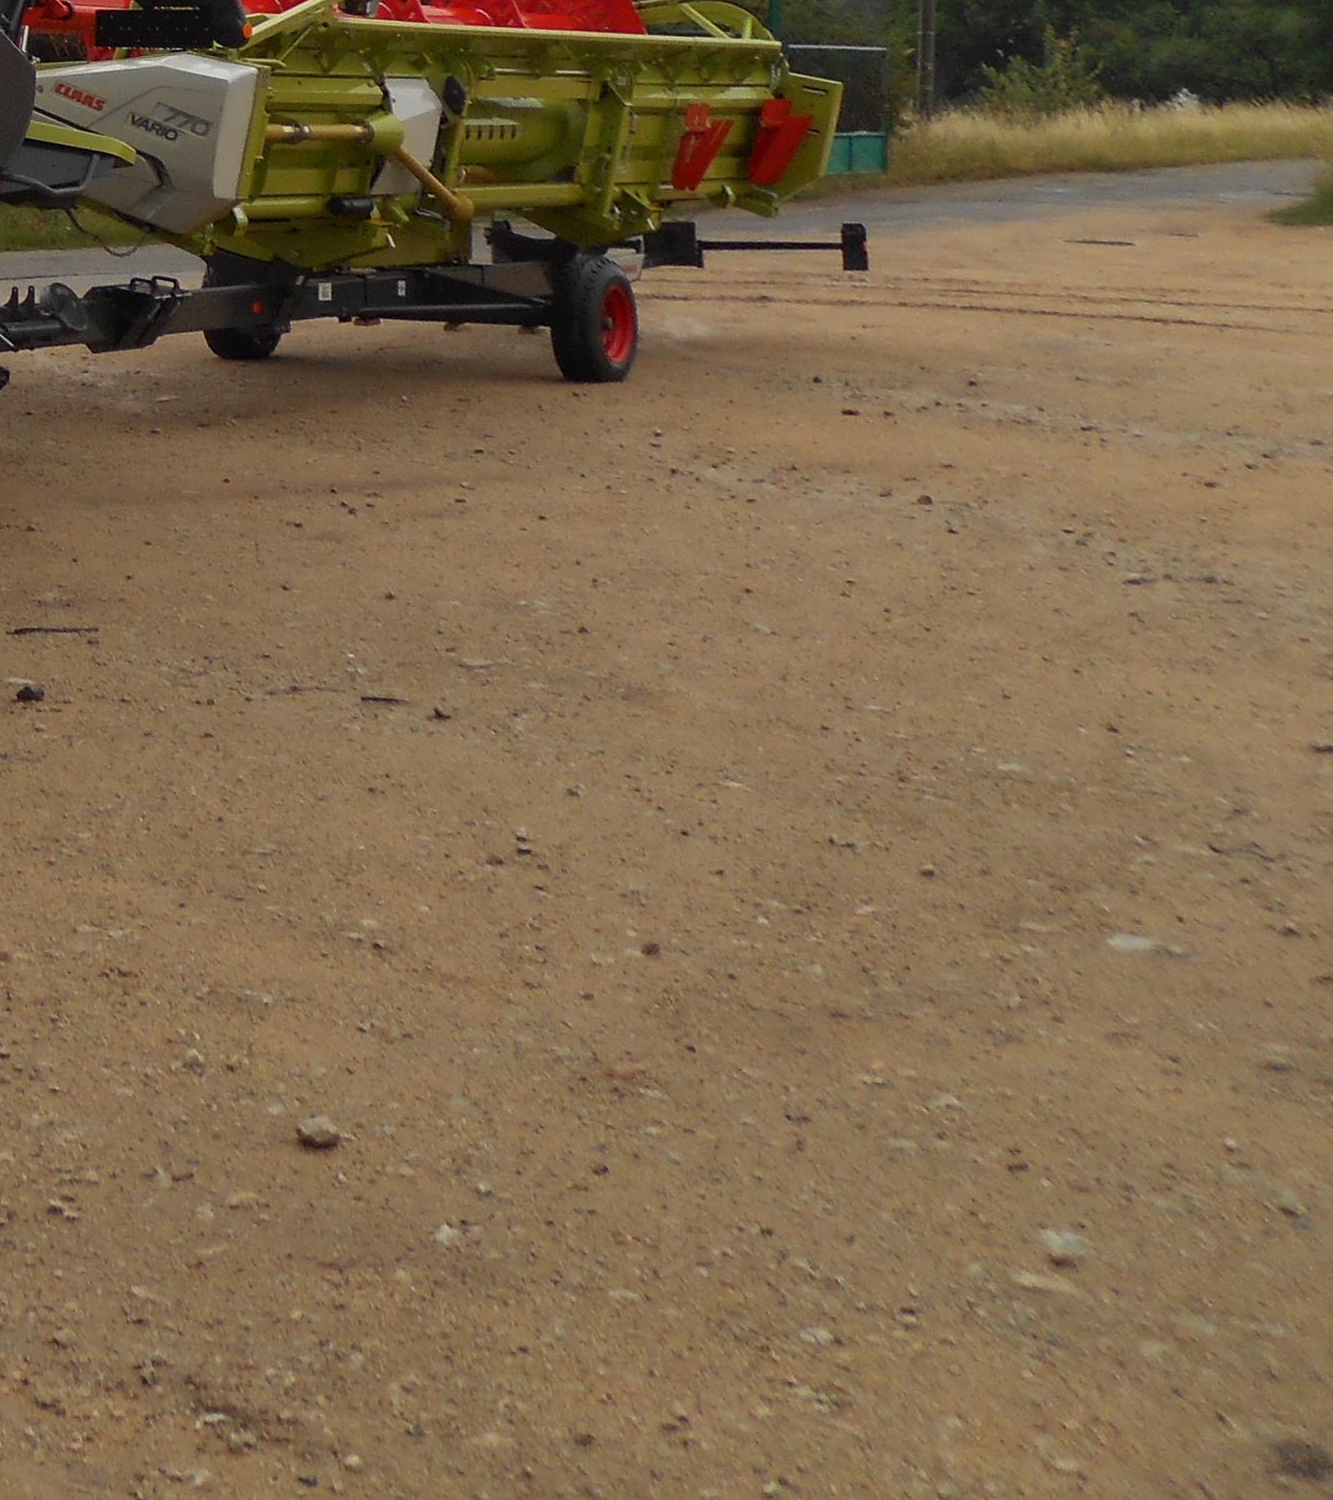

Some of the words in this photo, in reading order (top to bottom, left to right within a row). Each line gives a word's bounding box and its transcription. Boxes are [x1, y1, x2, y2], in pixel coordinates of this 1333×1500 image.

[55, 83, 106, 112] CLAAS
[130, 113, 178, 141] VARIO
[153, 102, 214, 137] 770
